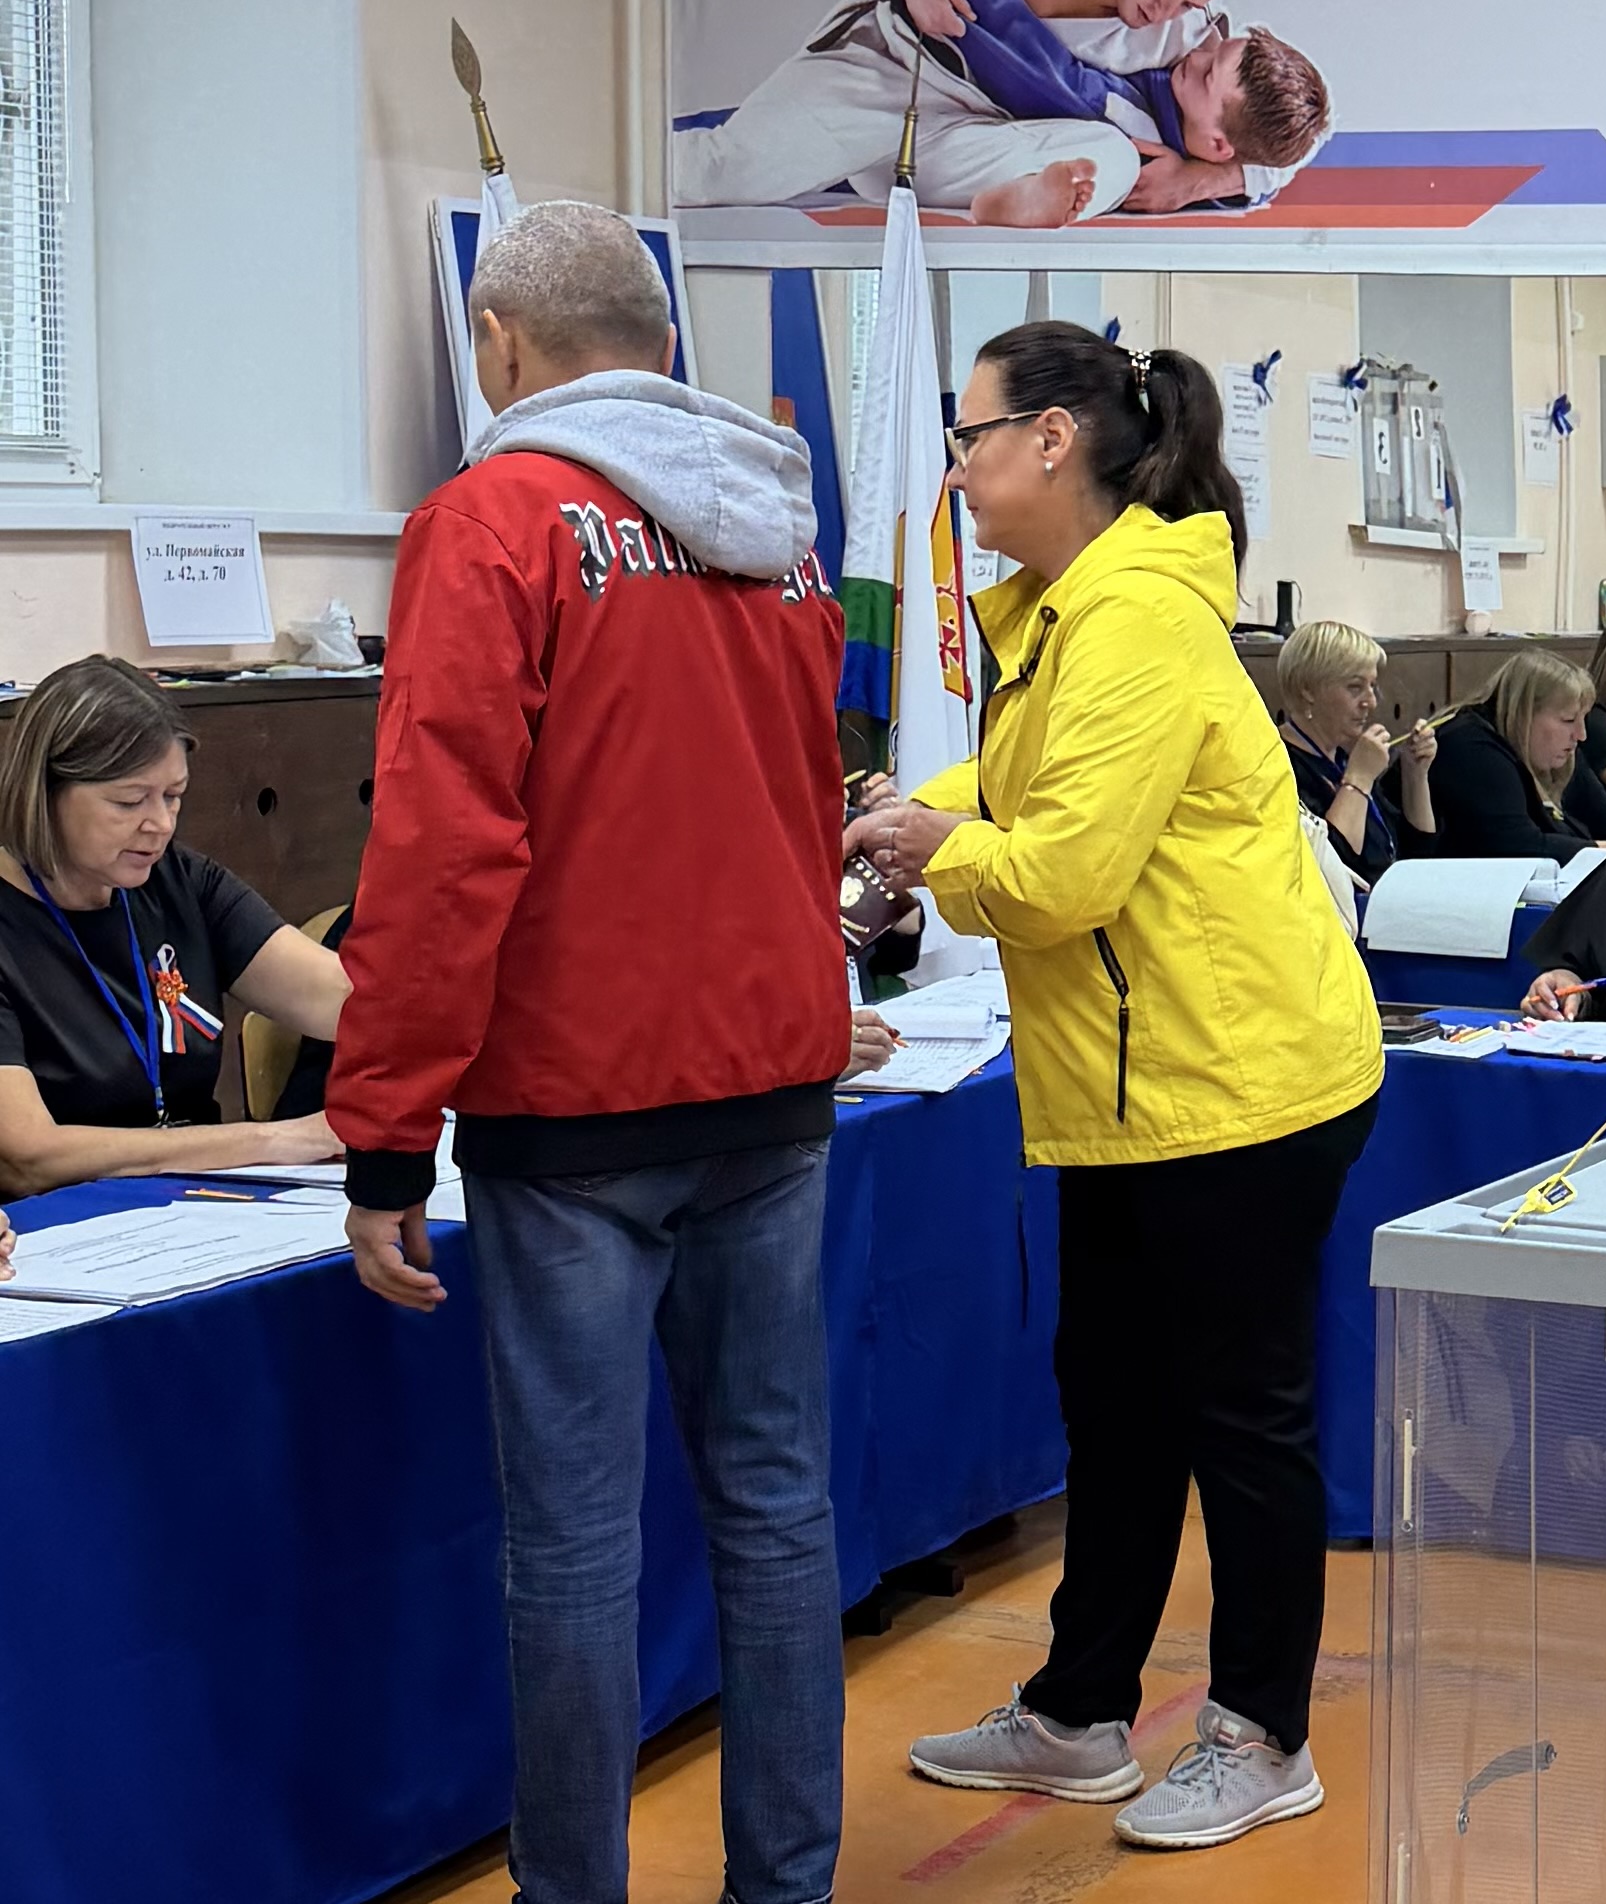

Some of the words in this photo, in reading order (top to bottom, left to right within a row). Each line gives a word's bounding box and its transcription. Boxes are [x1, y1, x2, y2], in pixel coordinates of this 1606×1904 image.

[146, 546, 162, 561] ул.
[165, 544, 245, 561] Первомайская
[164, 569, 175, 582] д.
[178, 565, 196, 583] 42,
[198, 569, 209, 581] д.
[212, 566, 226, 581] 70
